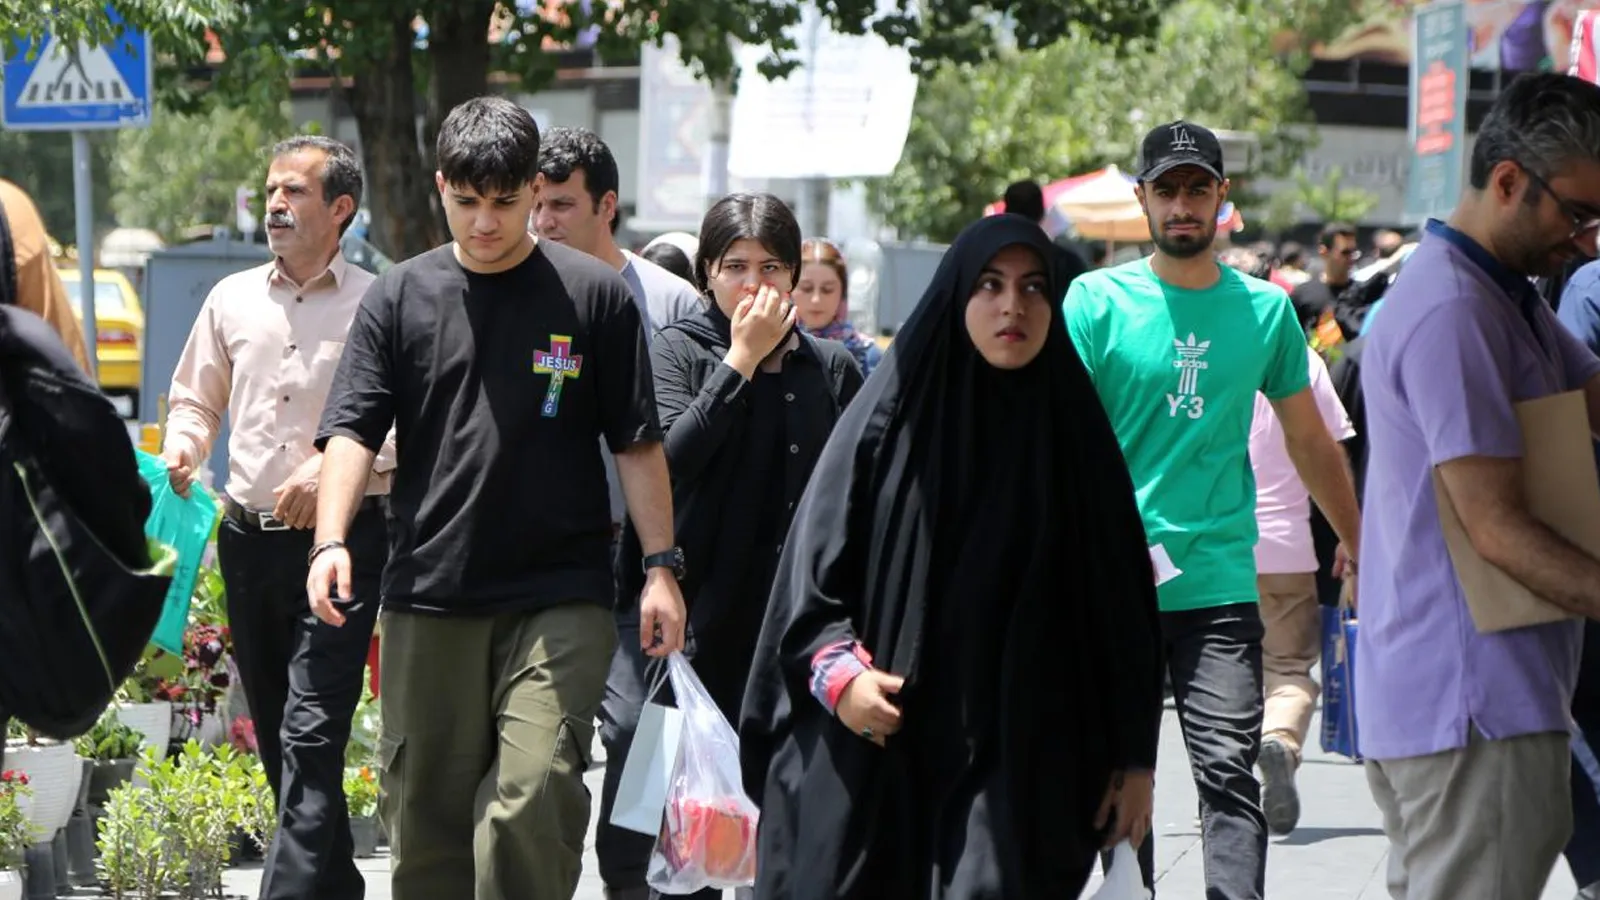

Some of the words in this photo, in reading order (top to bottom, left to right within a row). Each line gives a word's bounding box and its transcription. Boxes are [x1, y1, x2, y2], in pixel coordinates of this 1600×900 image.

[1170, 124, 1199, 151] LA
[537, 355, 577, 371] JESUS
[1173, 356, 1208, 369] adidas
[544, 369, 562, 413] KING
[1166, 393, 1204, 419] Y-3
